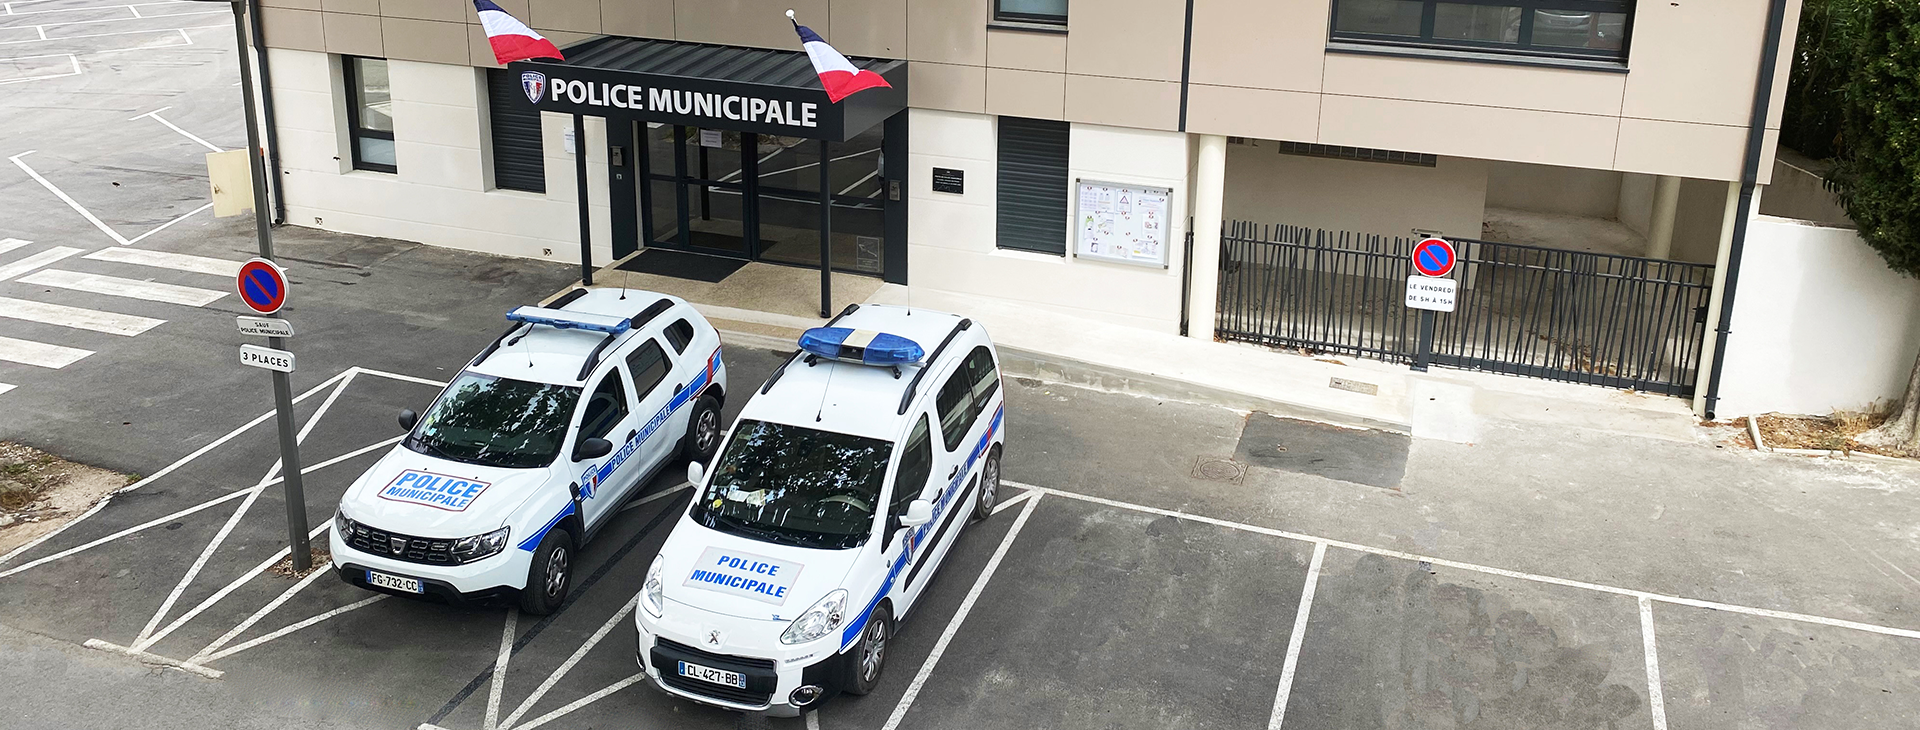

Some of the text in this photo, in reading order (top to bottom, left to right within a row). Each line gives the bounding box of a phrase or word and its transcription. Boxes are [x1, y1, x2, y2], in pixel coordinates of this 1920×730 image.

[551, 78, 818, 127] POLICE MUNICIPALE
[243, 352, 288, 367] 3 PLACES
[611, 405, 670, 470] POLICE MUNICIPALE
[396, 472, 483, 498] POLICE
[386, 486, 469, 508] MUNICIPALE
[717, 555, 780, 577] POLICE
[371, 573, 418, 591] FG-732-CC
[690, 569, 787, 598] MUNICIPALE
[687, 664, 738, 685] CL-427-BB
